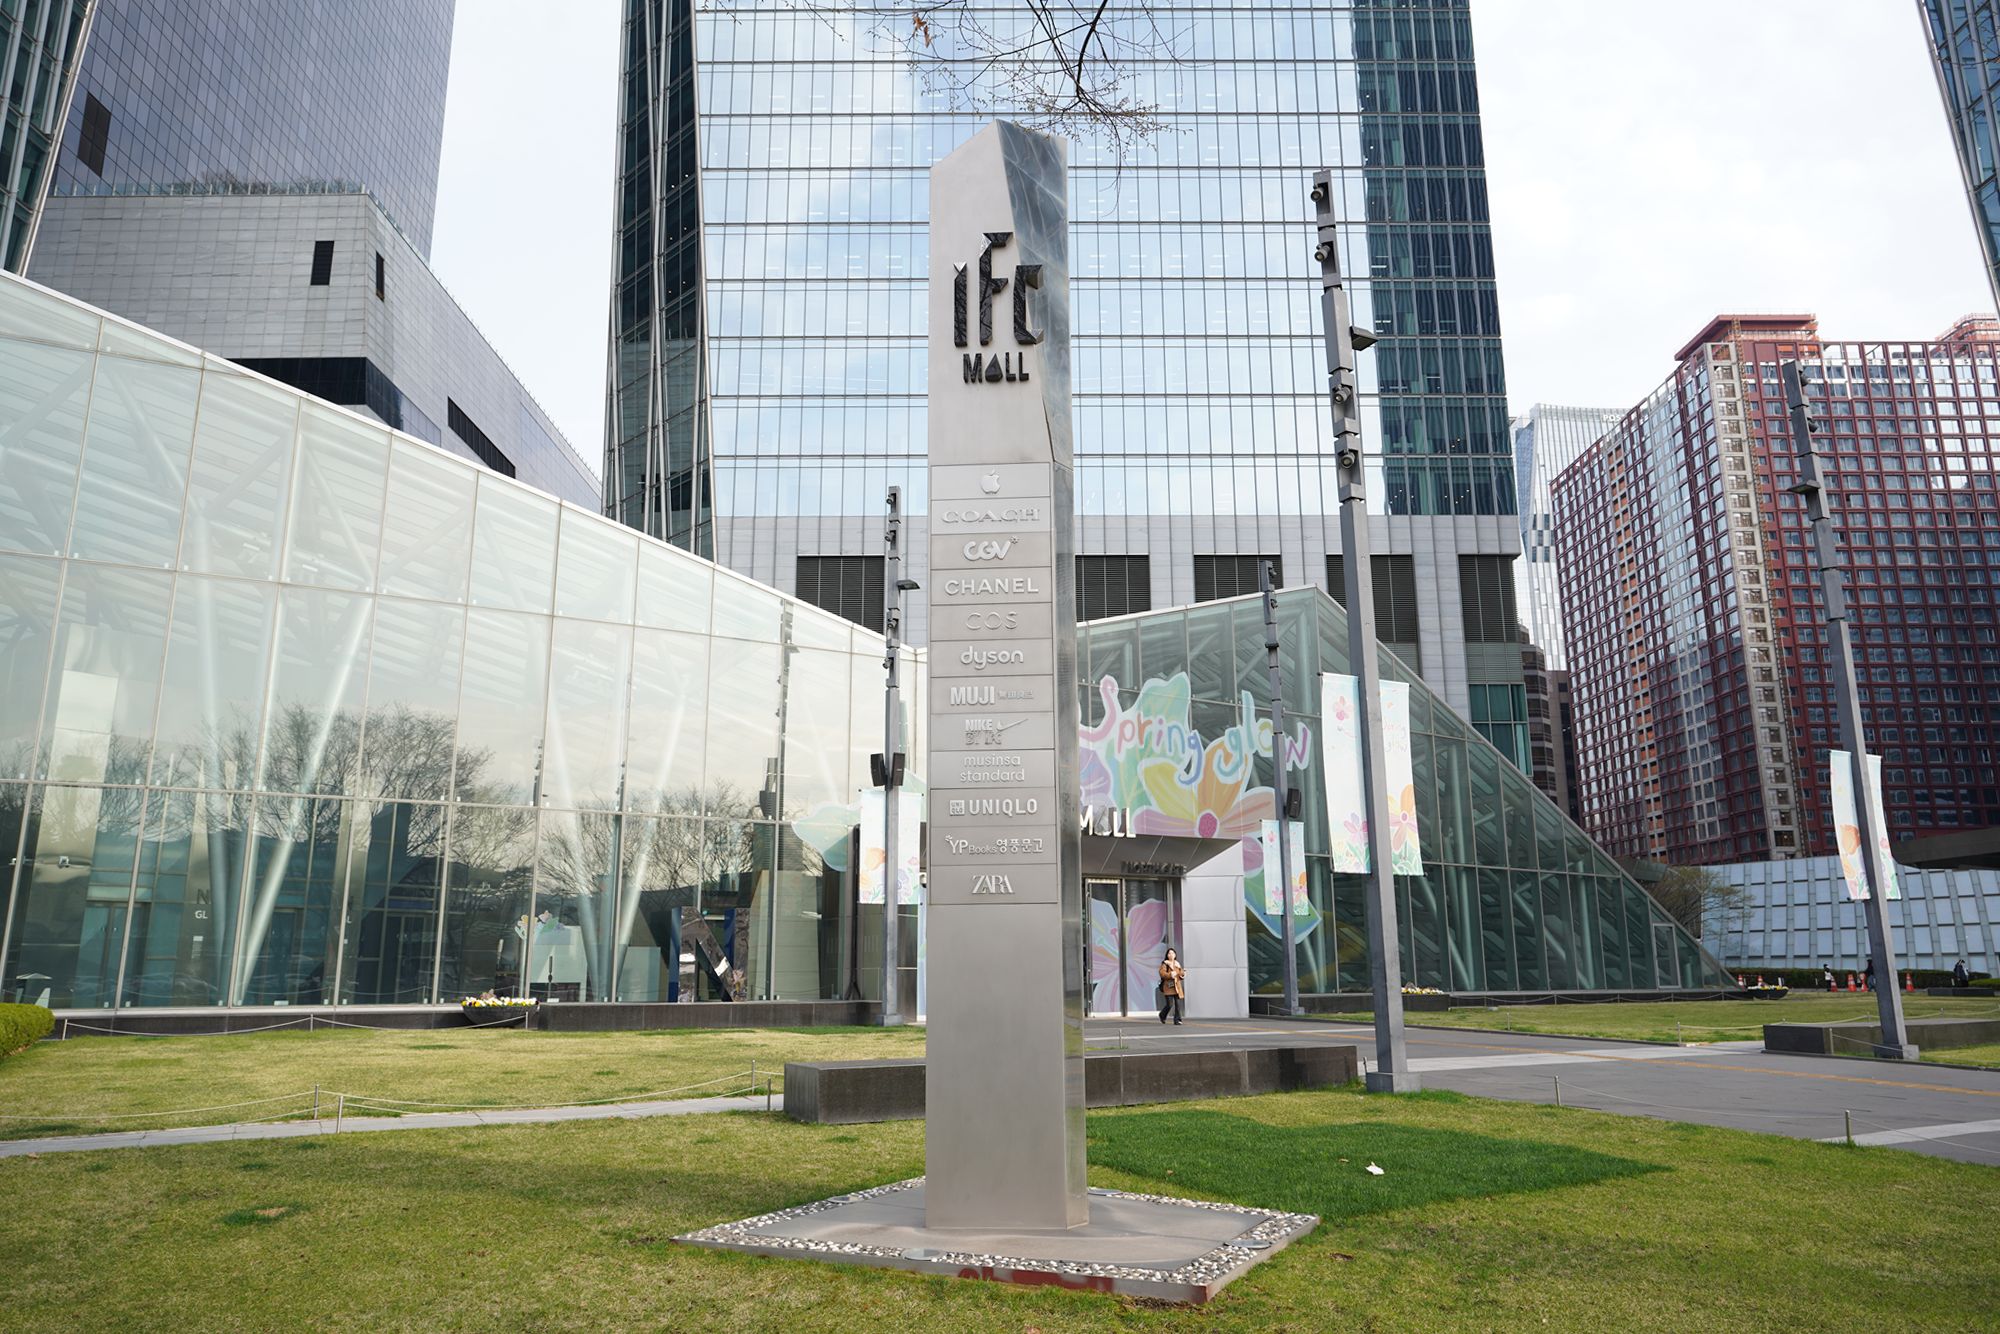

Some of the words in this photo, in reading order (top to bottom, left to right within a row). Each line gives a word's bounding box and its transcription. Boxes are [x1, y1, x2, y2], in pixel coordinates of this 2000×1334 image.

[963, 352, 1030, 383] MALL
[941, 508, 1040, 523] COACH
[963, 540, 1011, 561] CGV
[944, 577, 1039, 596] CHANEL
[965, 611, 1018, 631] COS
[960, 645, 1024, 670] dyson
[950, 686, 995, 706] MUJI
[964, 719, 993, 732] NIKE
[1080, 674, 1204, 786] Spring
[963, 753, 1021, 767] musinsa
[960, 769, 1025, 783] standard
[969, 798, 1038, 817] UNIQLO
[996, 838, 1044, 854] 영풍문고
[972, 874, 1014, 895] ZARA
